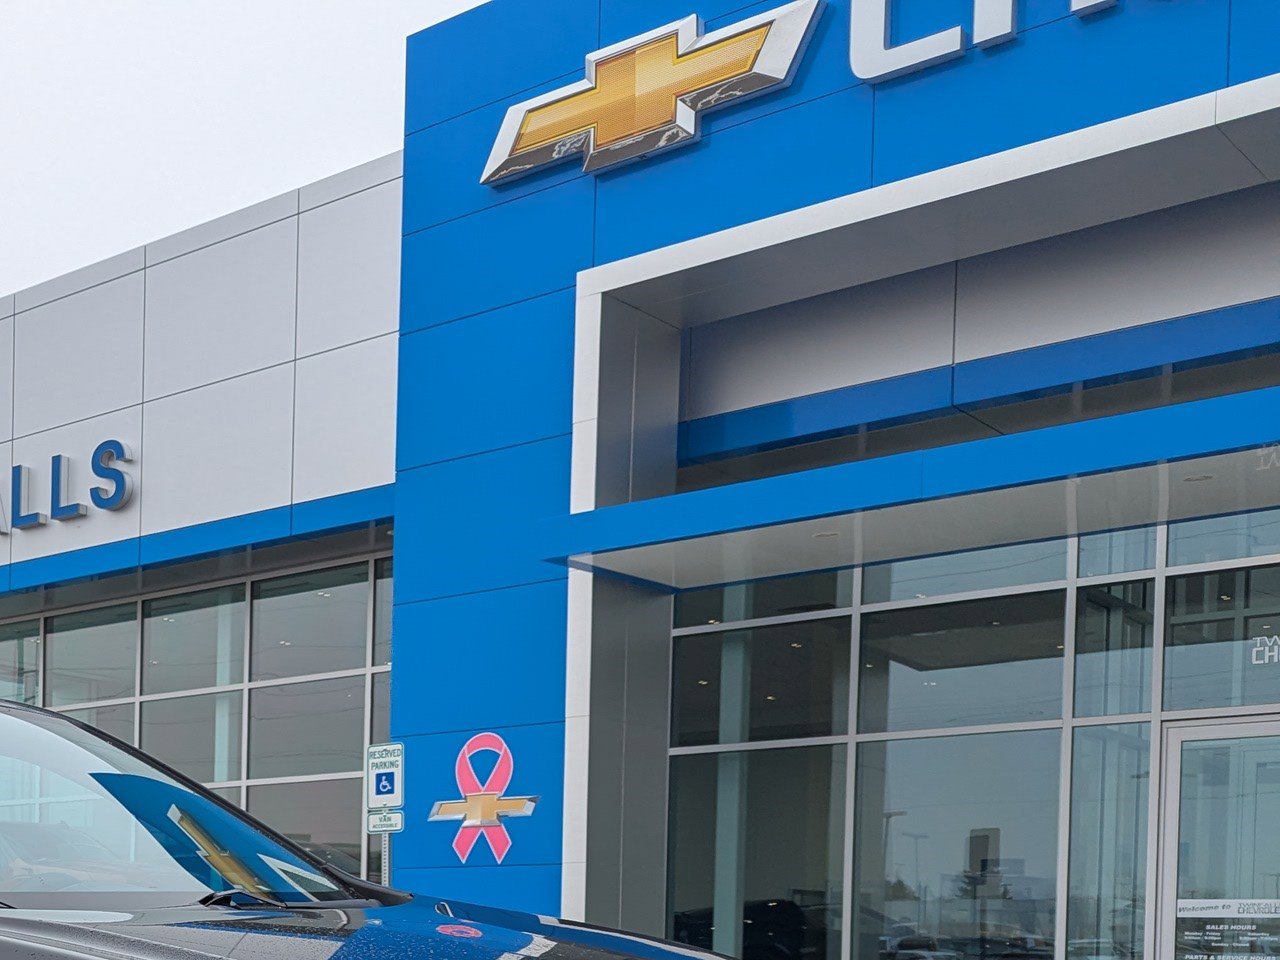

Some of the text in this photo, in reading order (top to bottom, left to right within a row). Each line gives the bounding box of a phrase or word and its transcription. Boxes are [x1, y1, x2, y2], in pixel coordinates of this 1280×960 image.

[369, 748, 401, 760] RESERVED
[371, 760, 399, 770] PARKING
[1179, 905, 1219, 913] Welcome
